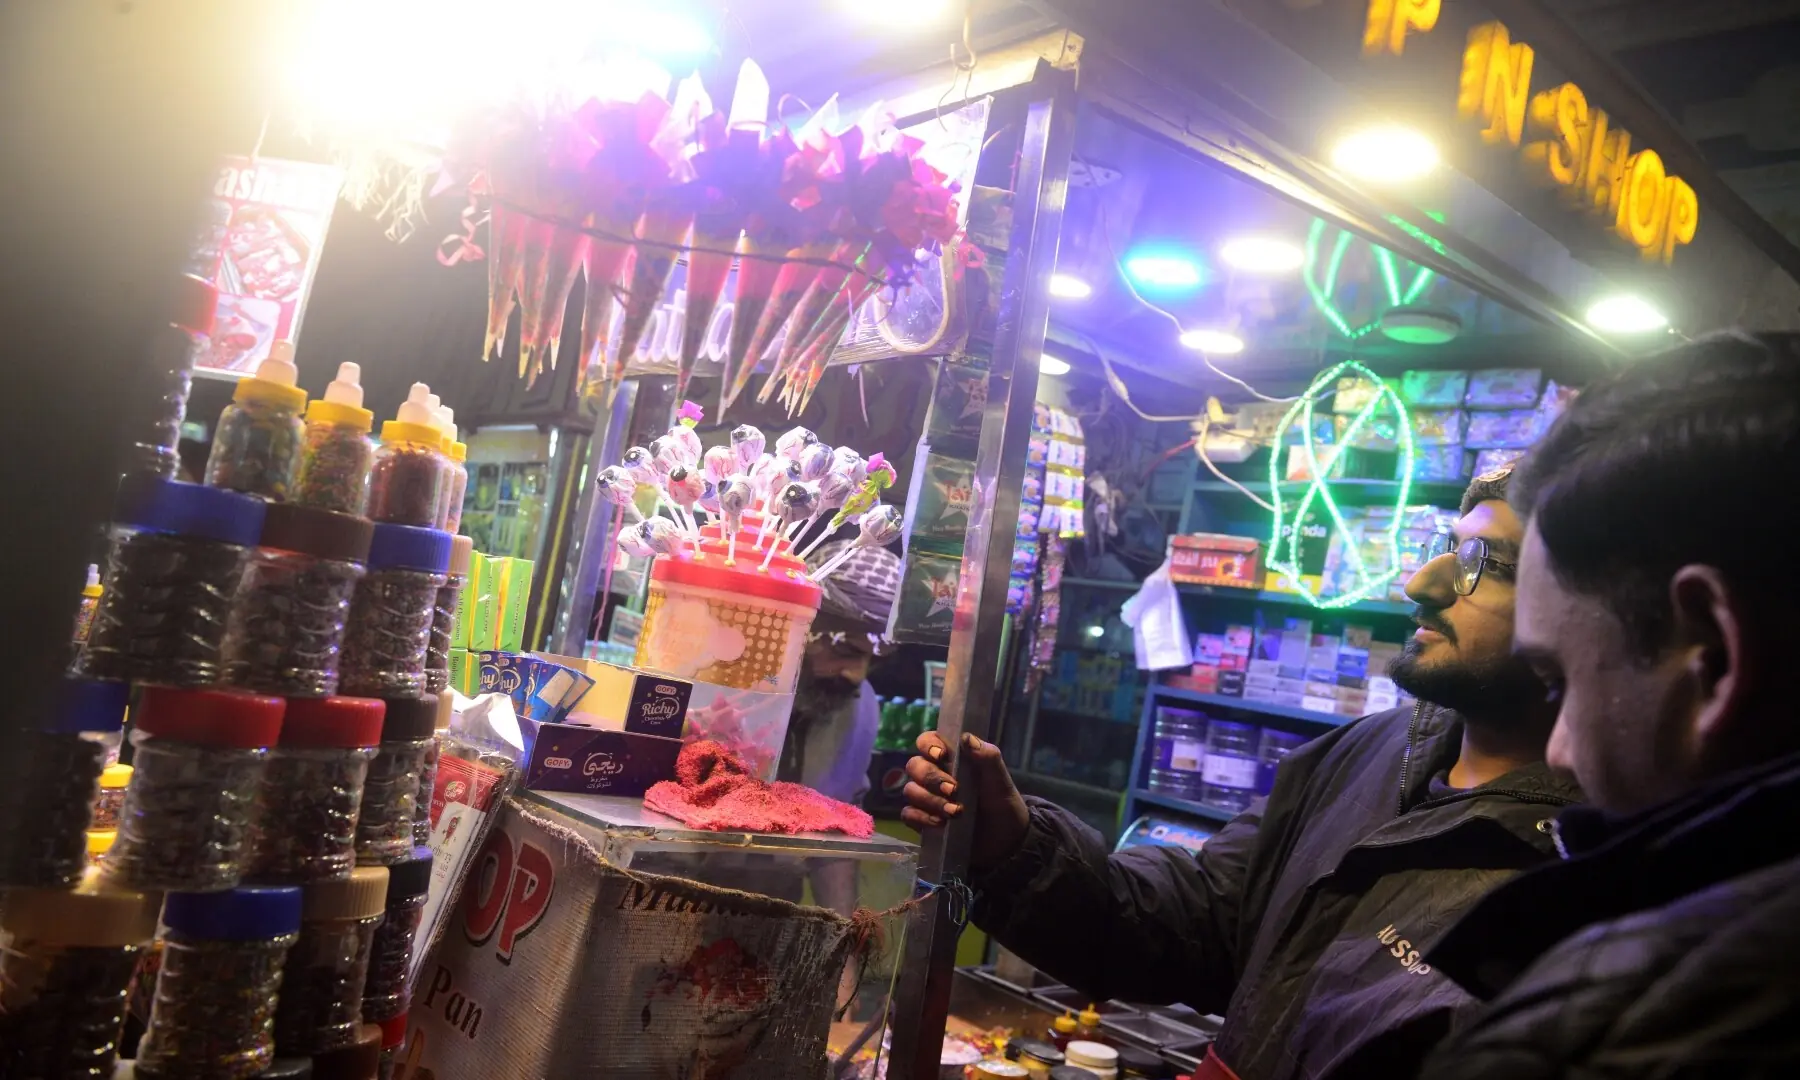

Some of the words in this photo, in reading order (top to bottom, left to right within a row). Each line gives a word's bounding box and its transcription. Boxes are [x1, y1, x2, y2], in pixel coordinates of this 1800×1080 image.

[1526, 82, 1698, 265] SHOP
[1281, 524, 1327, 540] pnda
[642, 701, 675, 719] Richy
[423, 965, 484, 1040] Pan
